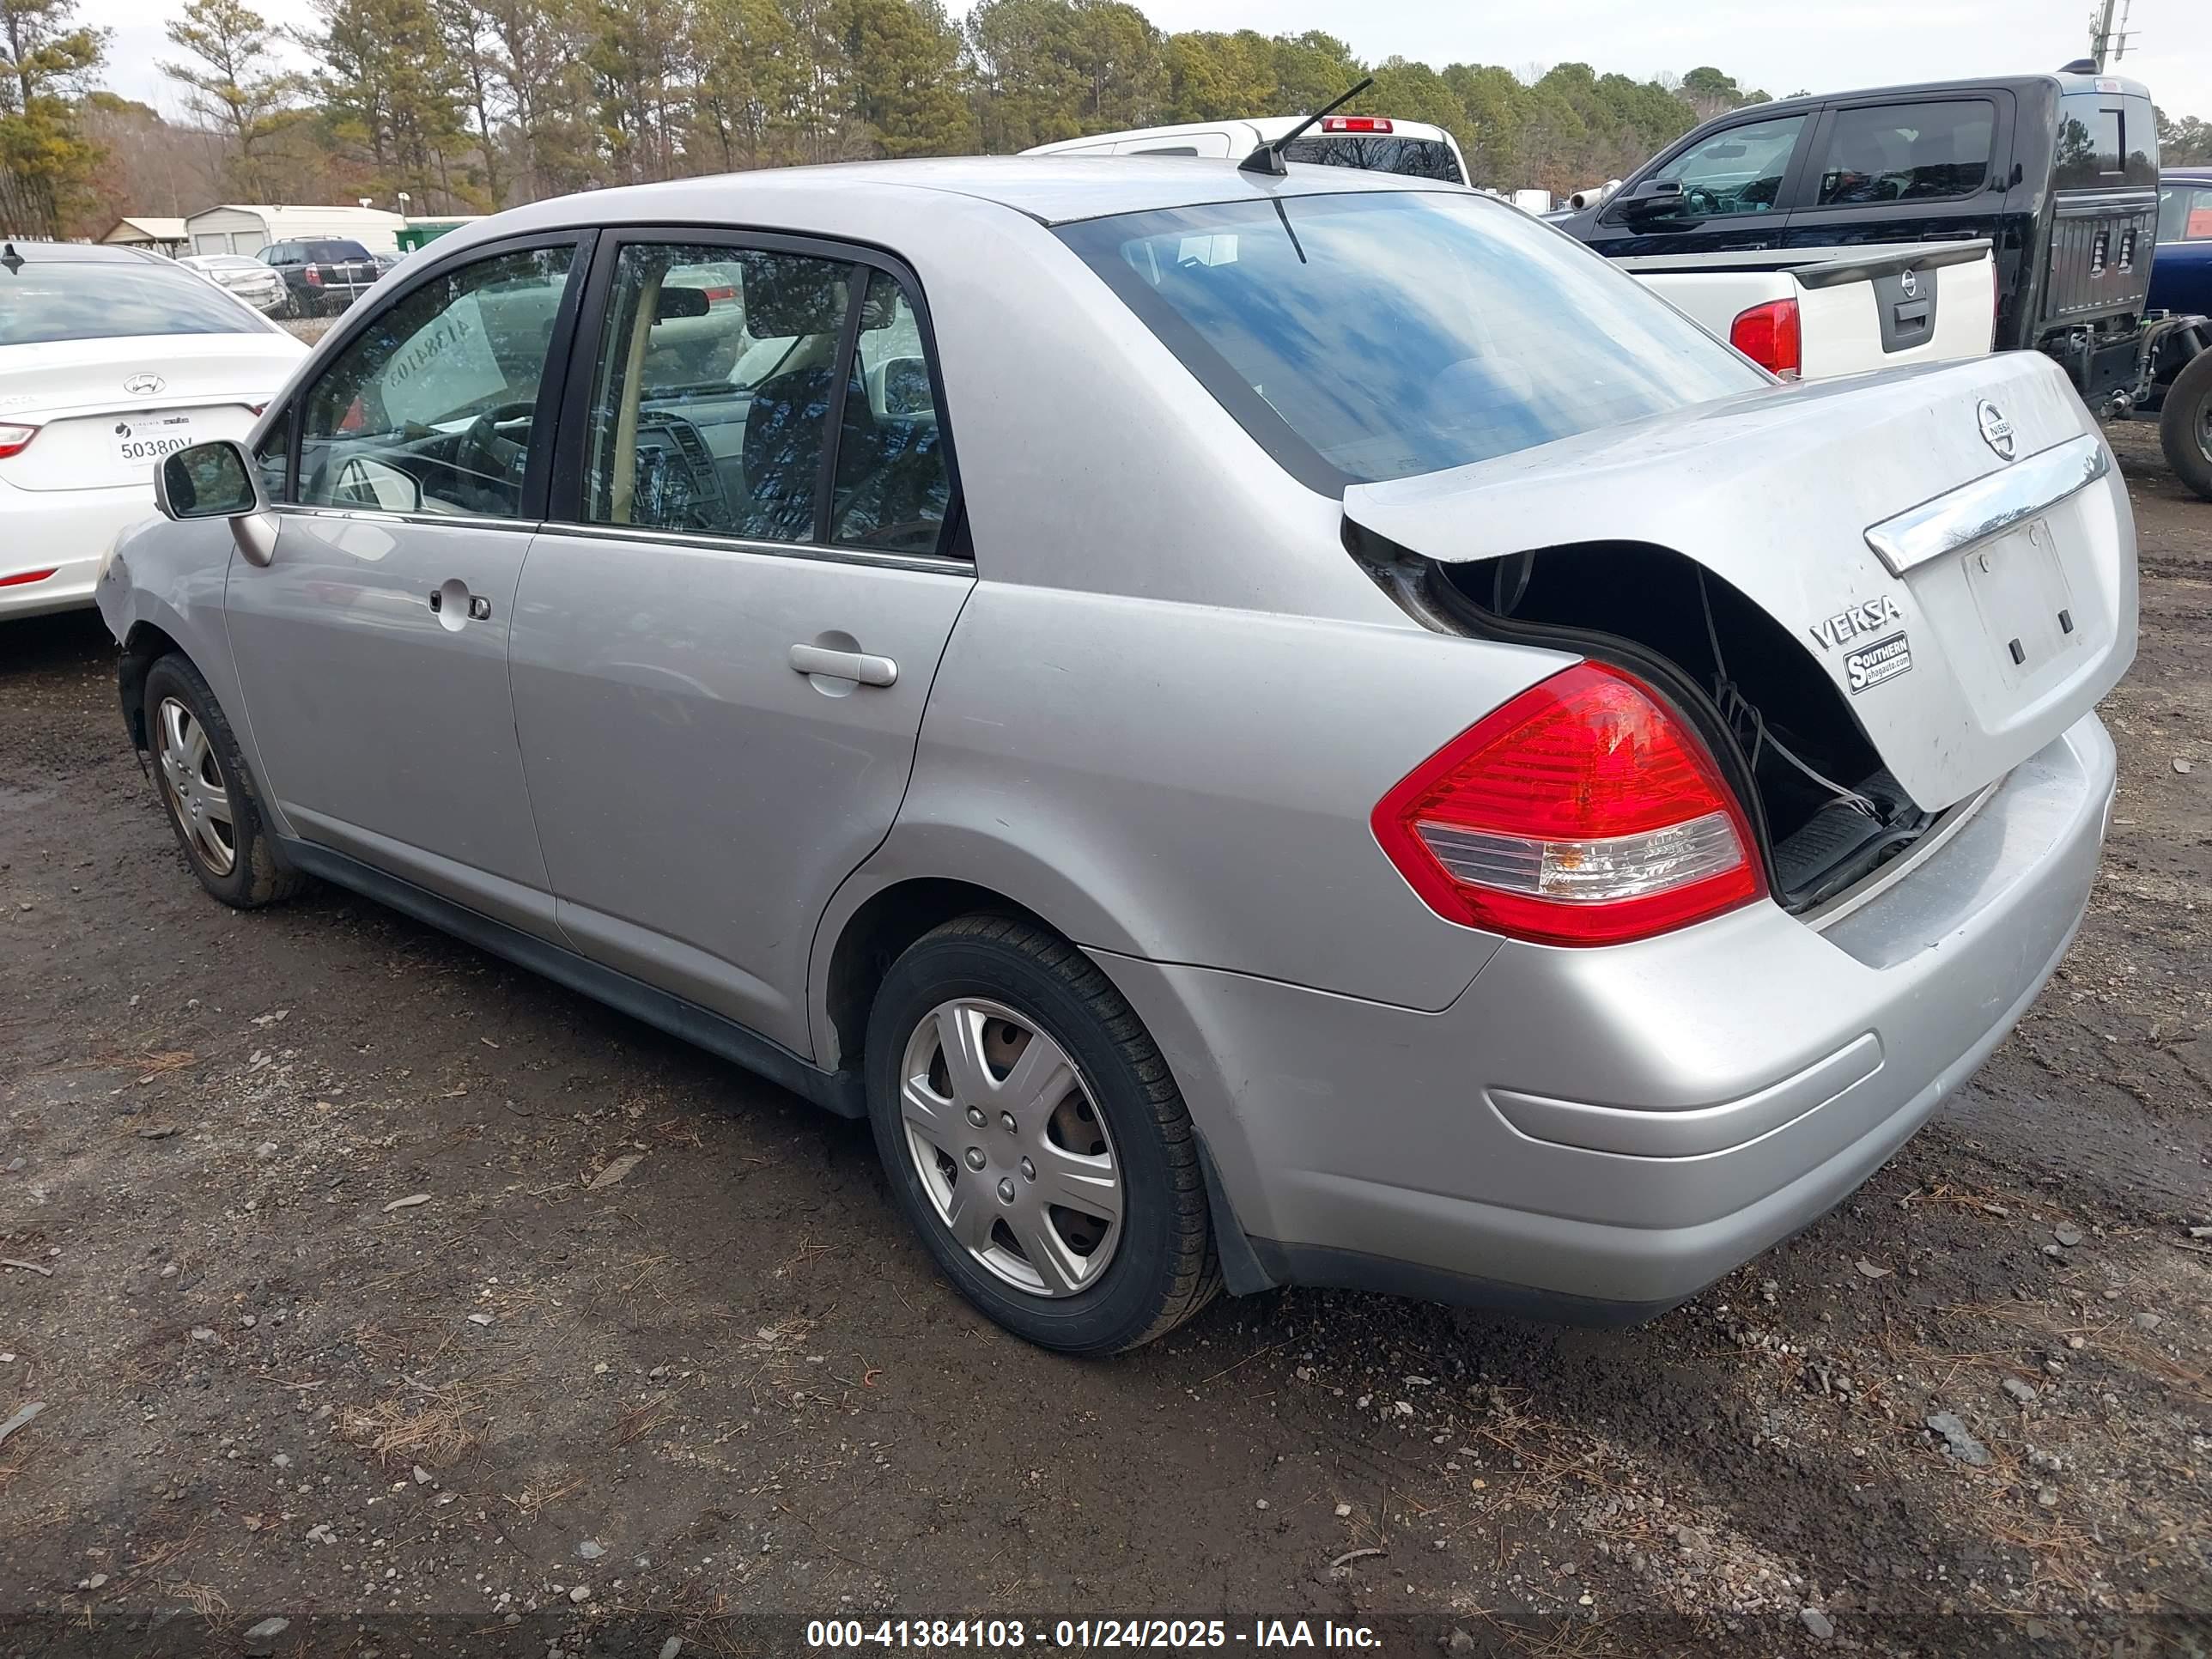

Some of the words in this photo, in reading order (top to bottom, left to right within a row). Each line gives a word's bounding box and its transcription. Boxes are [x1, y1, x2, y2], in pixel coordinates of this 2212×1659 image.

[1990, 420, 2012, 437] NISSA
[1809, 594, 1903, 650] VERSA
[1847, 637, 1908, 688] SOUTHERN
[1867, 656, 1910, 680] shagauto.com
